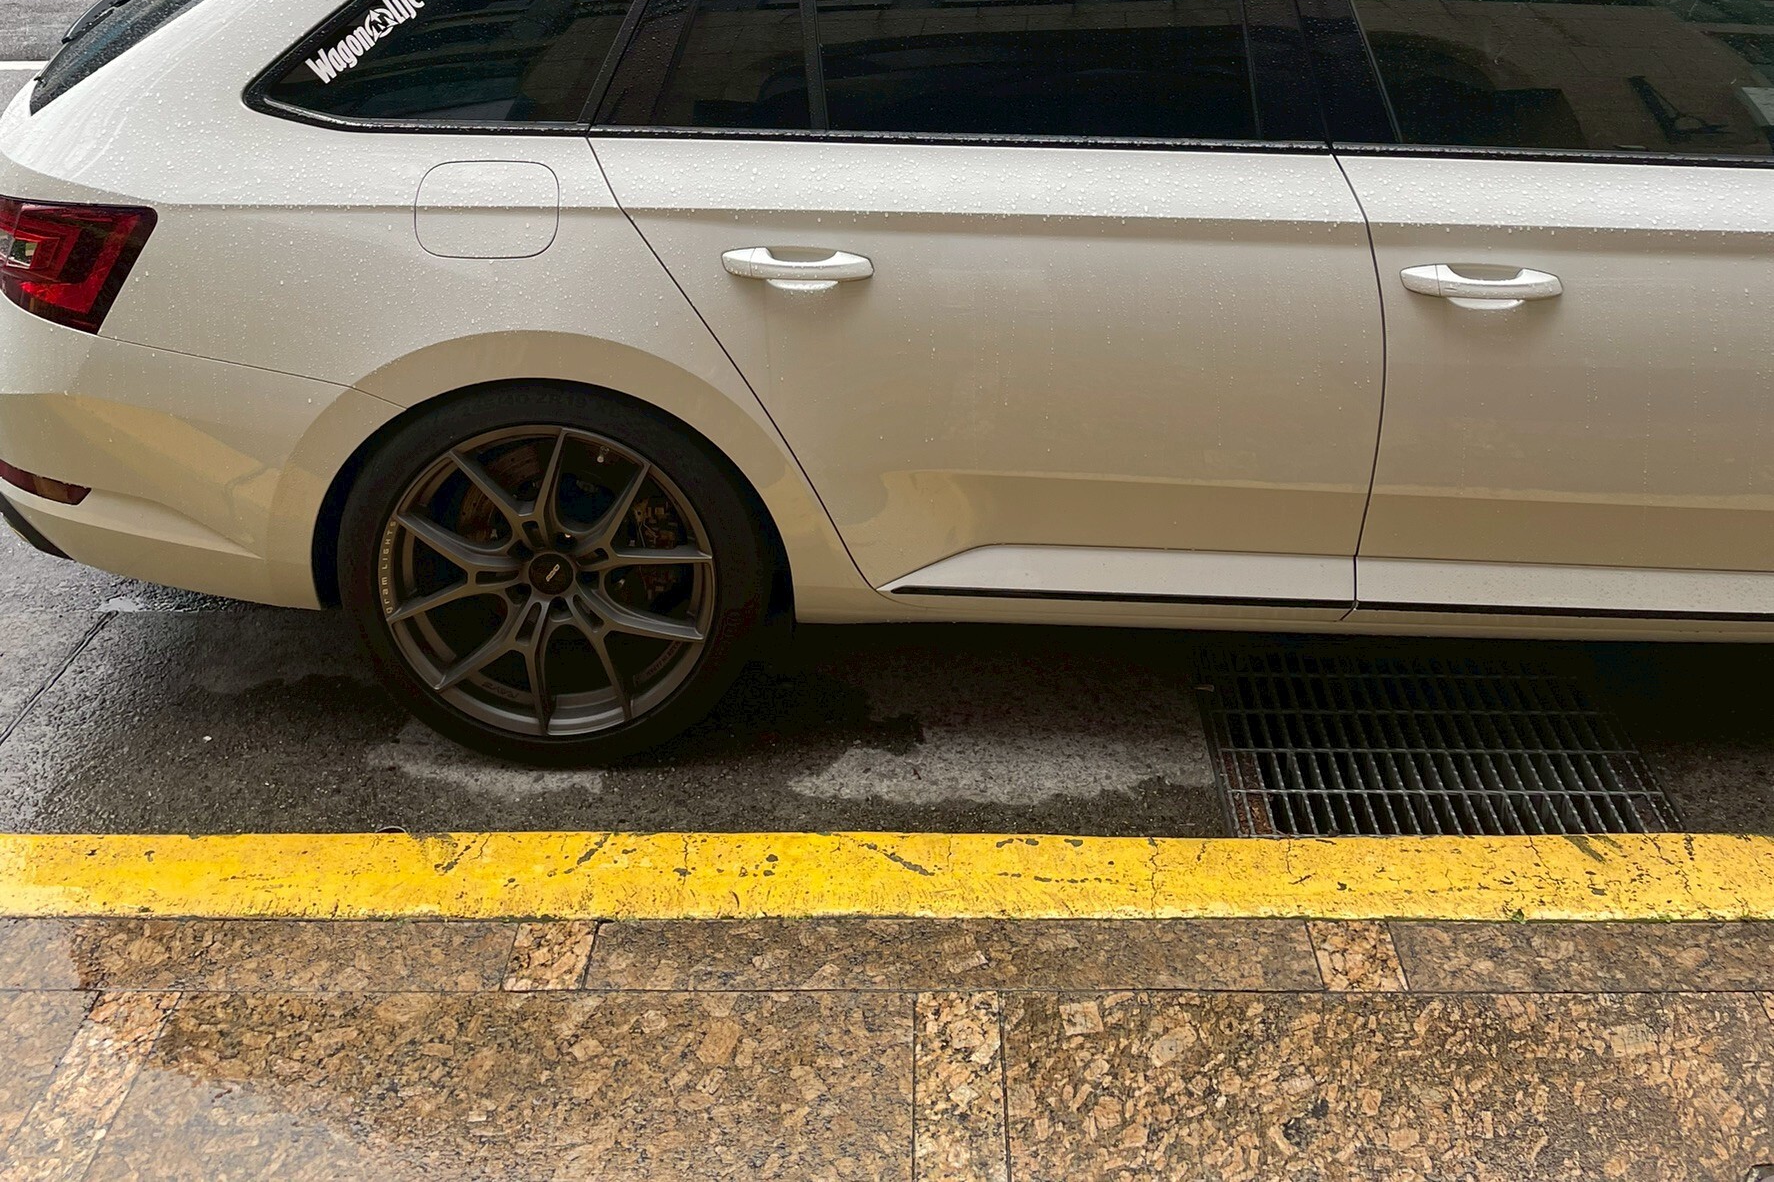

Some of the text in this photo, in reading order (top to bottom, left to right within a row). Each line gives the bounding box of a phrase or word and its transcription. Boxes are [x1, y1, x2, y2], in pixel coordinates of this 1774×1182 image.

[305, 25, 376, 84] Wagon
[381, 521, 396, 614] gram LIGHTS
